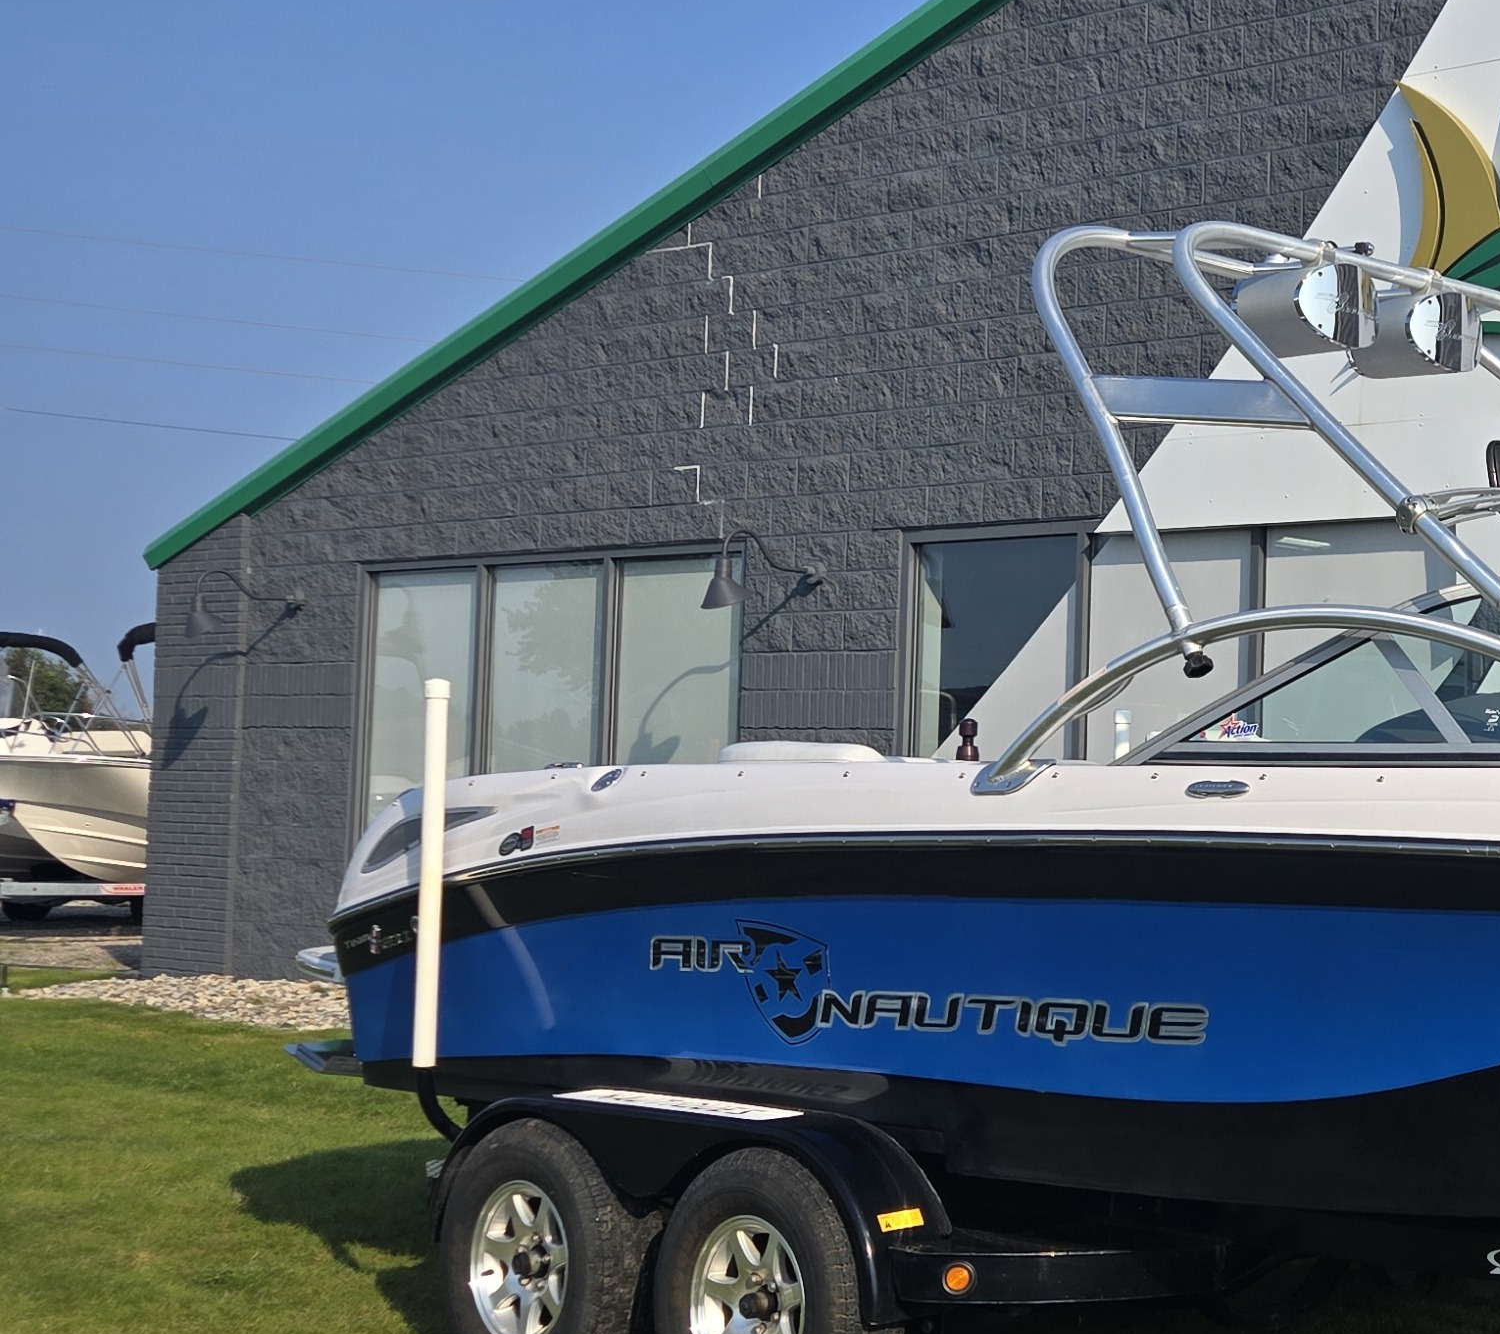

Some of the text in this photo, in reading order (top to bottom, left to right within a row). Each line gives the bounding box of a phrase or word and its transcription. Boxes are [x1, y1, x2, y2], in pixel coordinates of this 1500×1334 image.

[1223, 722, 1257, 738] Action
[650, 934, 754, 974] AIR
[816, 988, 1210, 1047] NAUTIQUE
